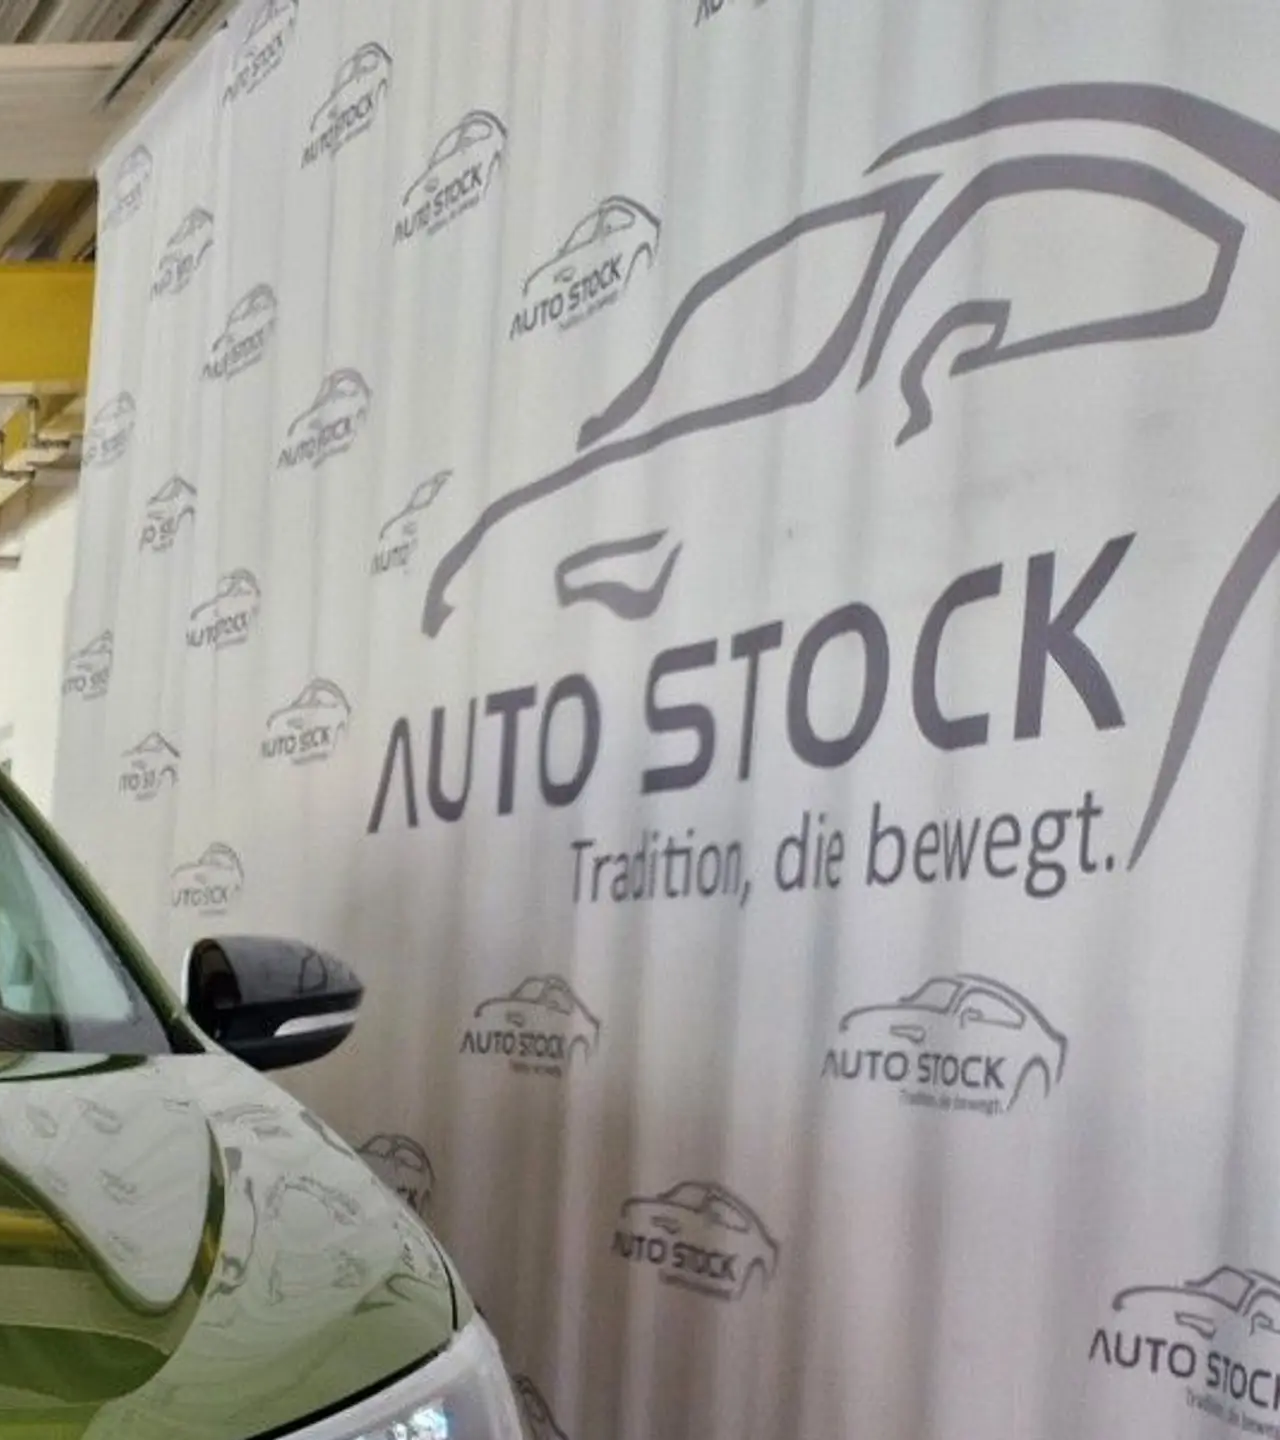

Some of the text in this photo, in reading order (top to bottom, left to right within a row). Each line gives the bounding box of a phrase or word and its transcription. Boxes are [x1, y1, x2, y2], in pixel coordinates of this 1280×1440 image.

[433, 163, 483, 217] STOCK
[510, 293, 564, 340] AUTO
[567, 253, 623, 311] STOCK
[367, 532, 1137, 834] AUTO STOCK
[571, 791, 1117, 908] Tradition, die bewegt.
[459, 1030, 516, 1055] AUTO
[821, 1050, 1005, 1088] AUTO STOCK
[1089, 1329, 1197, 1378] AUTO
